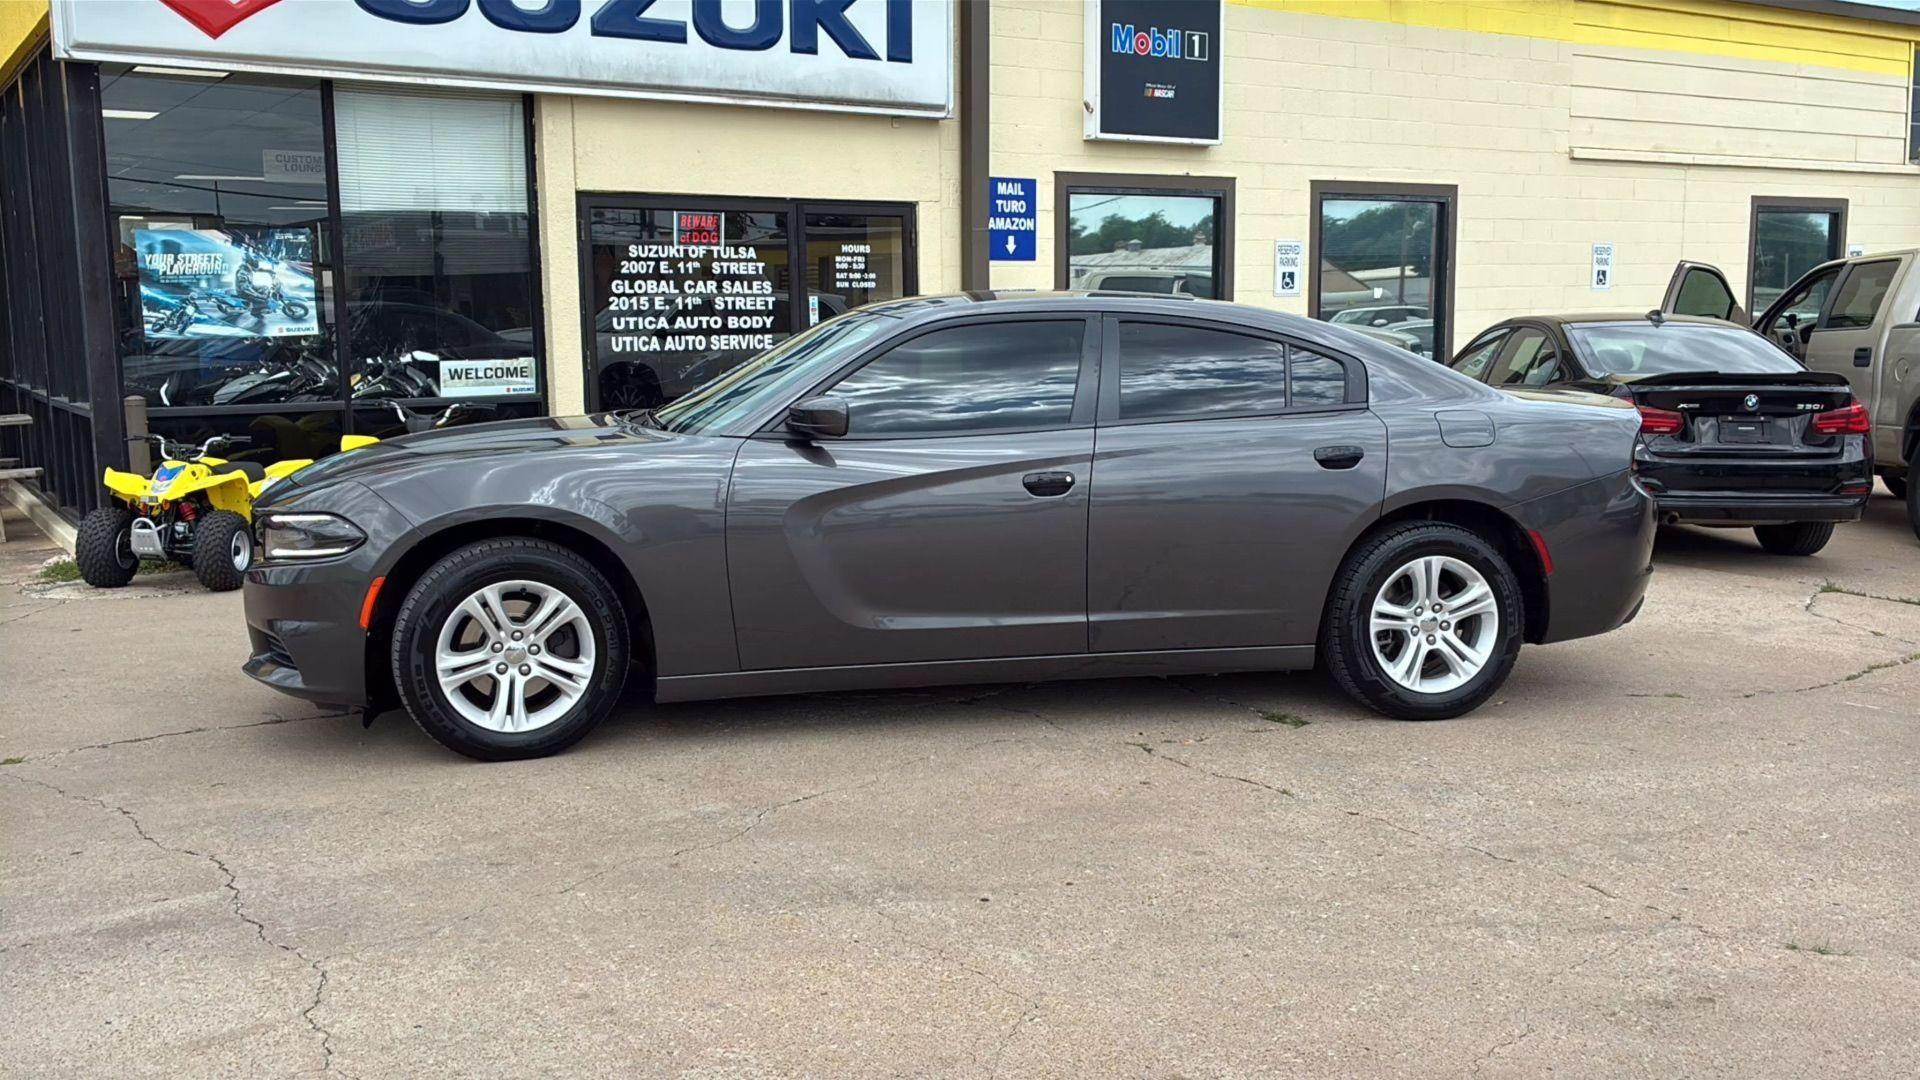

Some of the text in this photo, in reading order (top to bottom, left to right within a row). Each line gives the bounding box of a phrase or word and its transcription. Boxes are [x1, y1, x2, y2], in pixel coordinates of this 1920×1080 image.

[355, 0, 913, 63] ZUKI
[1112, 23, 1181, 58] Mobil
[1153, 88, 1175, 98] NASCAR
[997, 182, 1024, 195] MAIL
[995, 199, 1026, 213] TURO
[680, 214, 719, 229] BEWARE
[988, 217, 1034, 231] AMAZON
[680, 232, 719, 243] of DOG
[628, 245, 757, 259] SUZUKI OF TULSA
[841, 244, 871, 253] HOURS
[144, 253, 223, 265] YOUR STREETS
[159, 263, 229, 275] PLAYGROUND
[620, 261, 766, 275] 2007 E. 11th STREET
[611, 280, 772, 294] GLOBAL CAR SALES
[609, 297, 776, 310] 2015 E. 11th STREET
[612, 316, 774, 330] UTICA AUTO BODY
[611, 334, 774, 352] UTICA AUTO SERVICE
[448, 366, 529, 380] WELCOME
